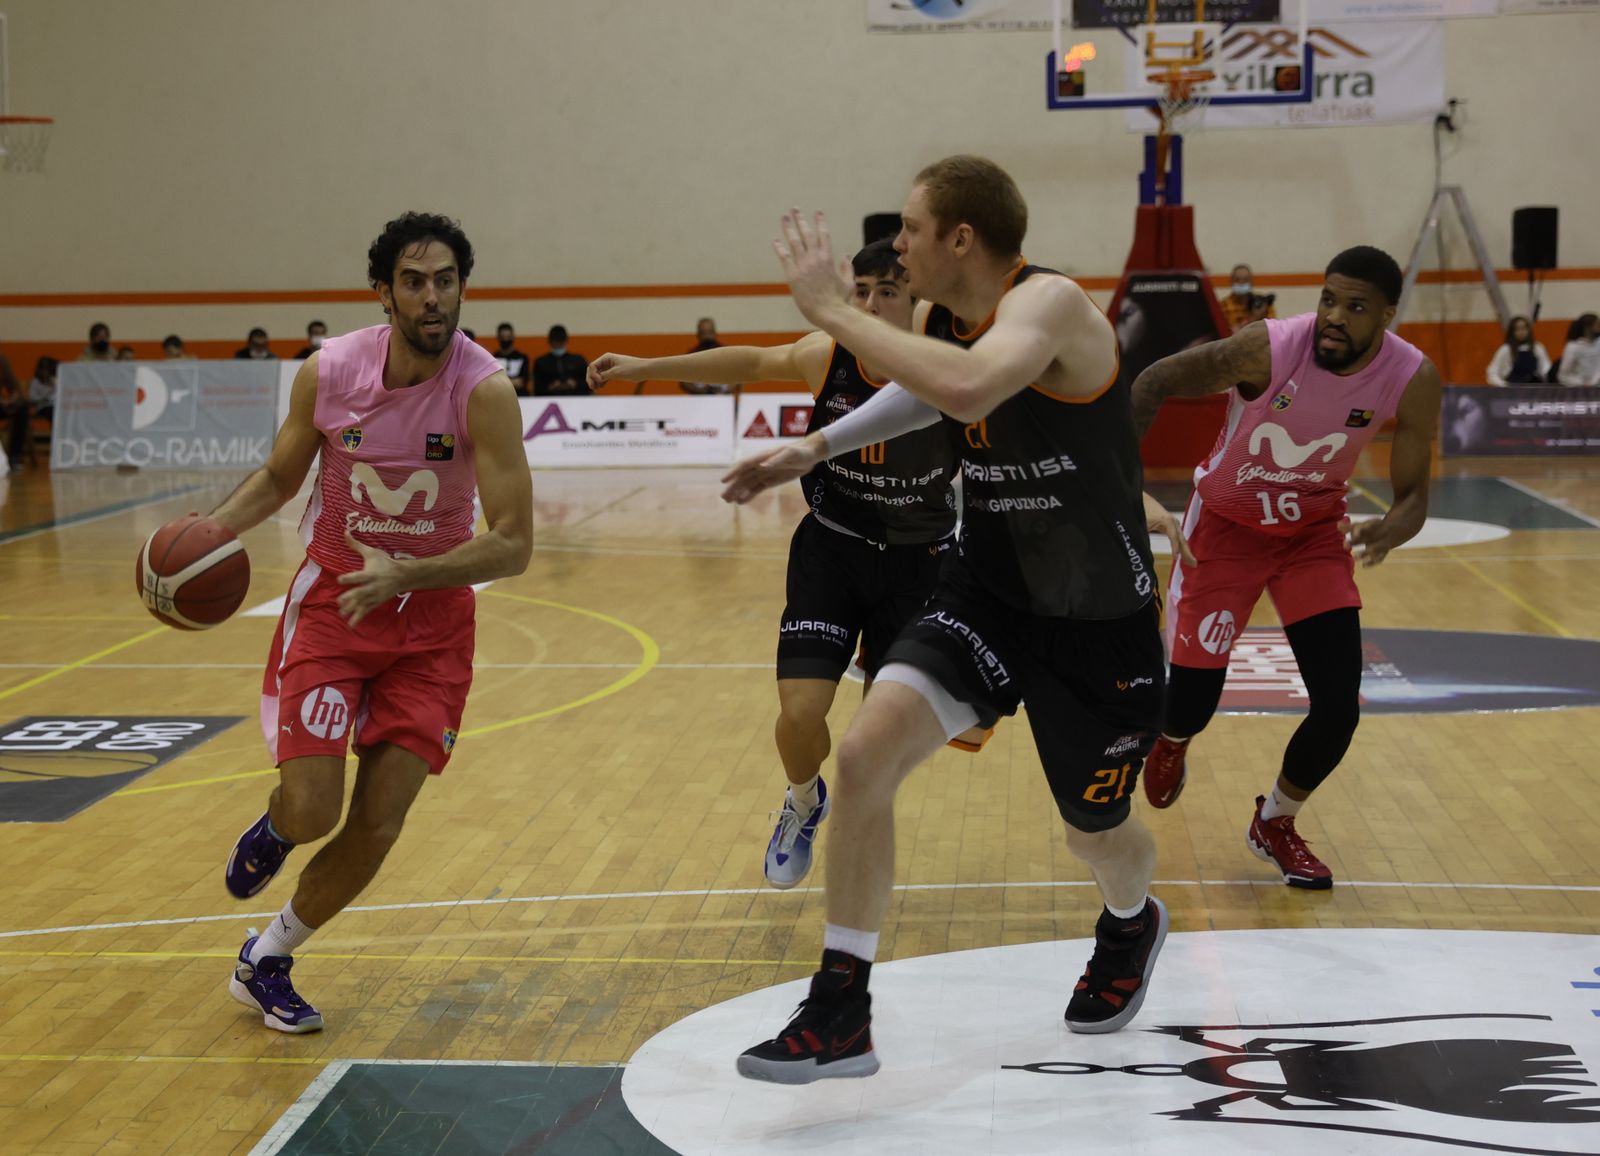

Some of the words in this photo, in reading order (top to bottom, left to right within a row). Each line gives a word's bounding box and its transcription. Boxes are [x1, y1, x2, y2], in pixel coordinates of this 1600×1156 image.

[58, 437, 268, 467] DECO-RAMIK
[823, 456, 907, 489] UARISTI
[345, 511, 436, 536] Estudiantes
[1256, 491, 1302, 526] 16
[780, 619, 849, 640] JUARISTI
[1199, 610, 1236, 655] hp
[923, 611, 1011, 687] JUARISTI
[301, 685, 349, 741] hp
[1082, 762, 1132, 803] 21
